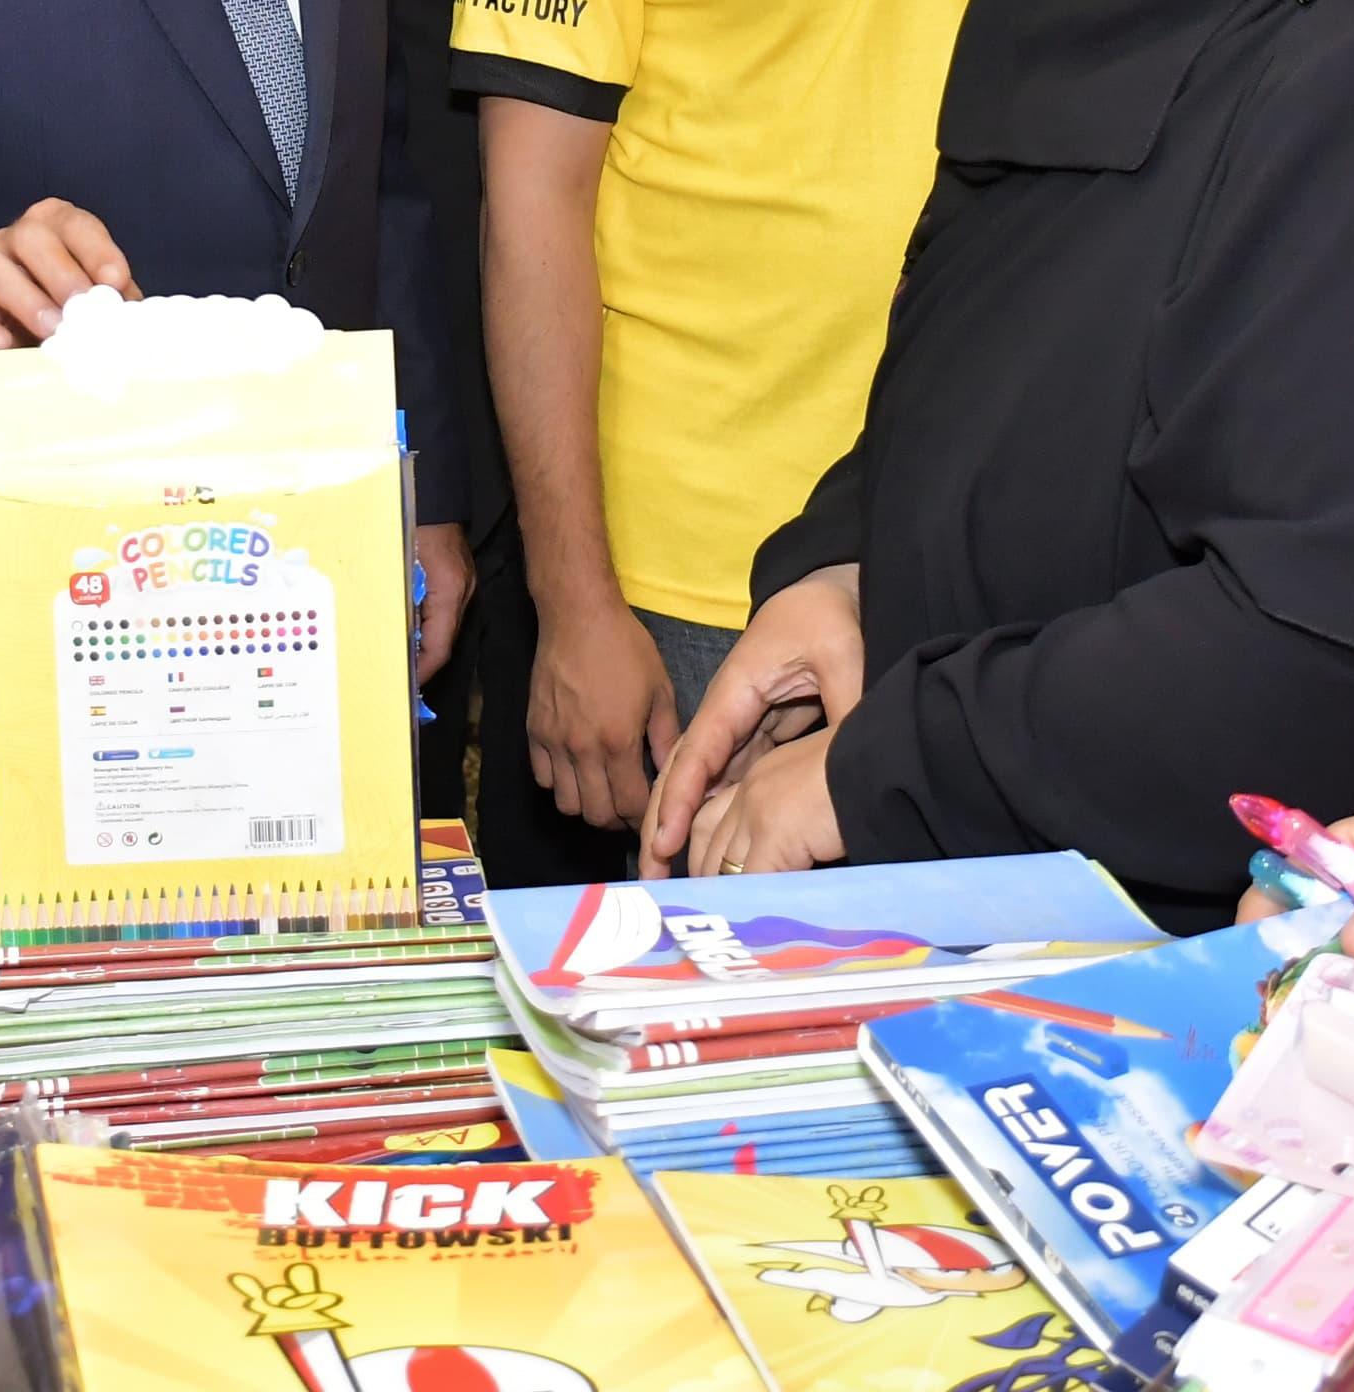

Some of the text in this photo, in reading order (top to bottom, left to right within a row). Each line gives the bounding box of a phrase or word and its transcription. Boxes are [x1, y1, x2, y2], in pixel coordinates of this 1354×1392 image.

[75, 575, 103, 594] 48
[983, 1082, 1163, 1254] POWER
[263, 1179, 556, 1228] KICK
[1164, 1205, 1195, 1227] 24
[257, 1224, 573, 1249] BUTTOWSKI
